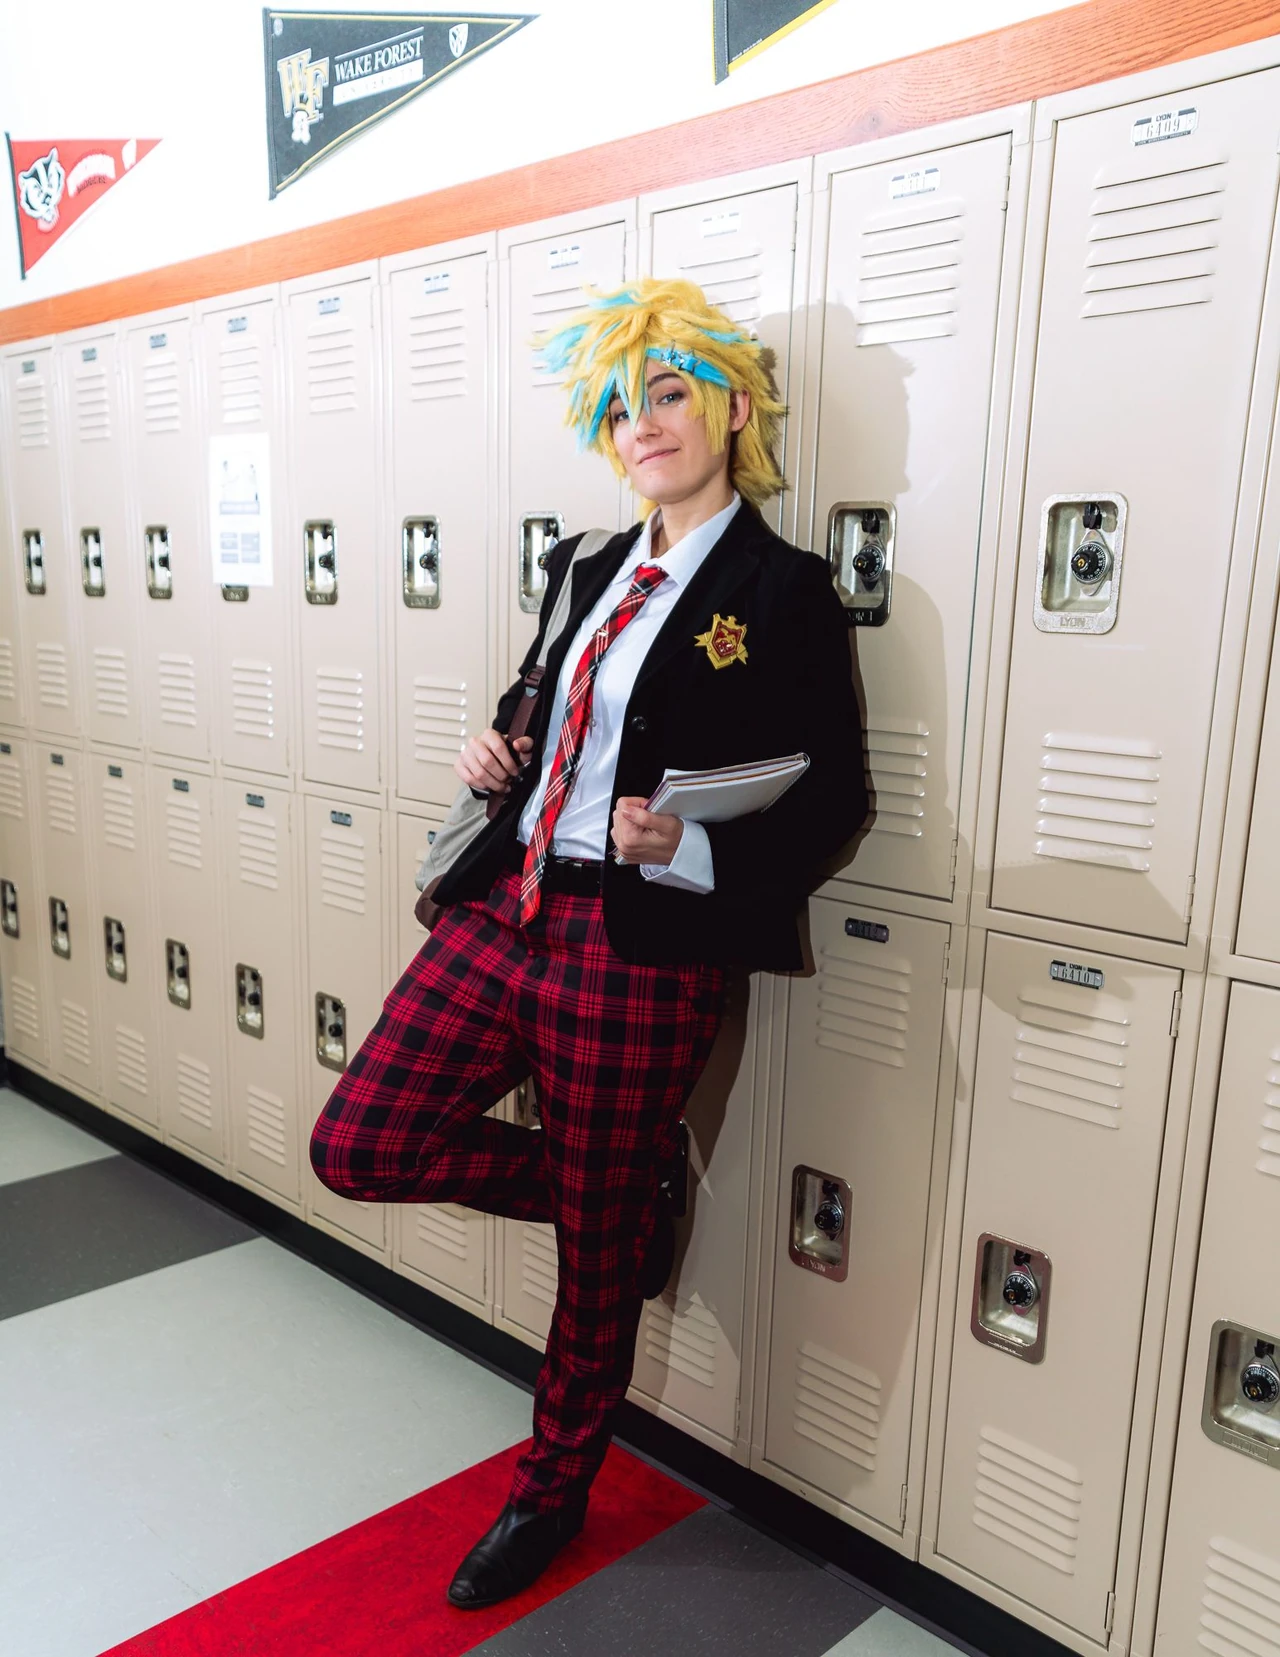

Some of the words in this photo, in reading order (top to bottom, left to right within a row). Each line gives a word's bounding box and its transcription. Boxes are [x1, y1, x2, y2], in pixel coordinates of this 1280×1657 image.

[335, 56, 372, 82] WAKE
[374, 35, 424, 69] FOREST
[277, 48, 330, 125] WF
[1155, 112, 1172, 122] LYON
[1146, 118, 1180, 138] 6409
[1062, 967, 1090, 983] 6410
[1069, 963, 1083, 971] LYON
